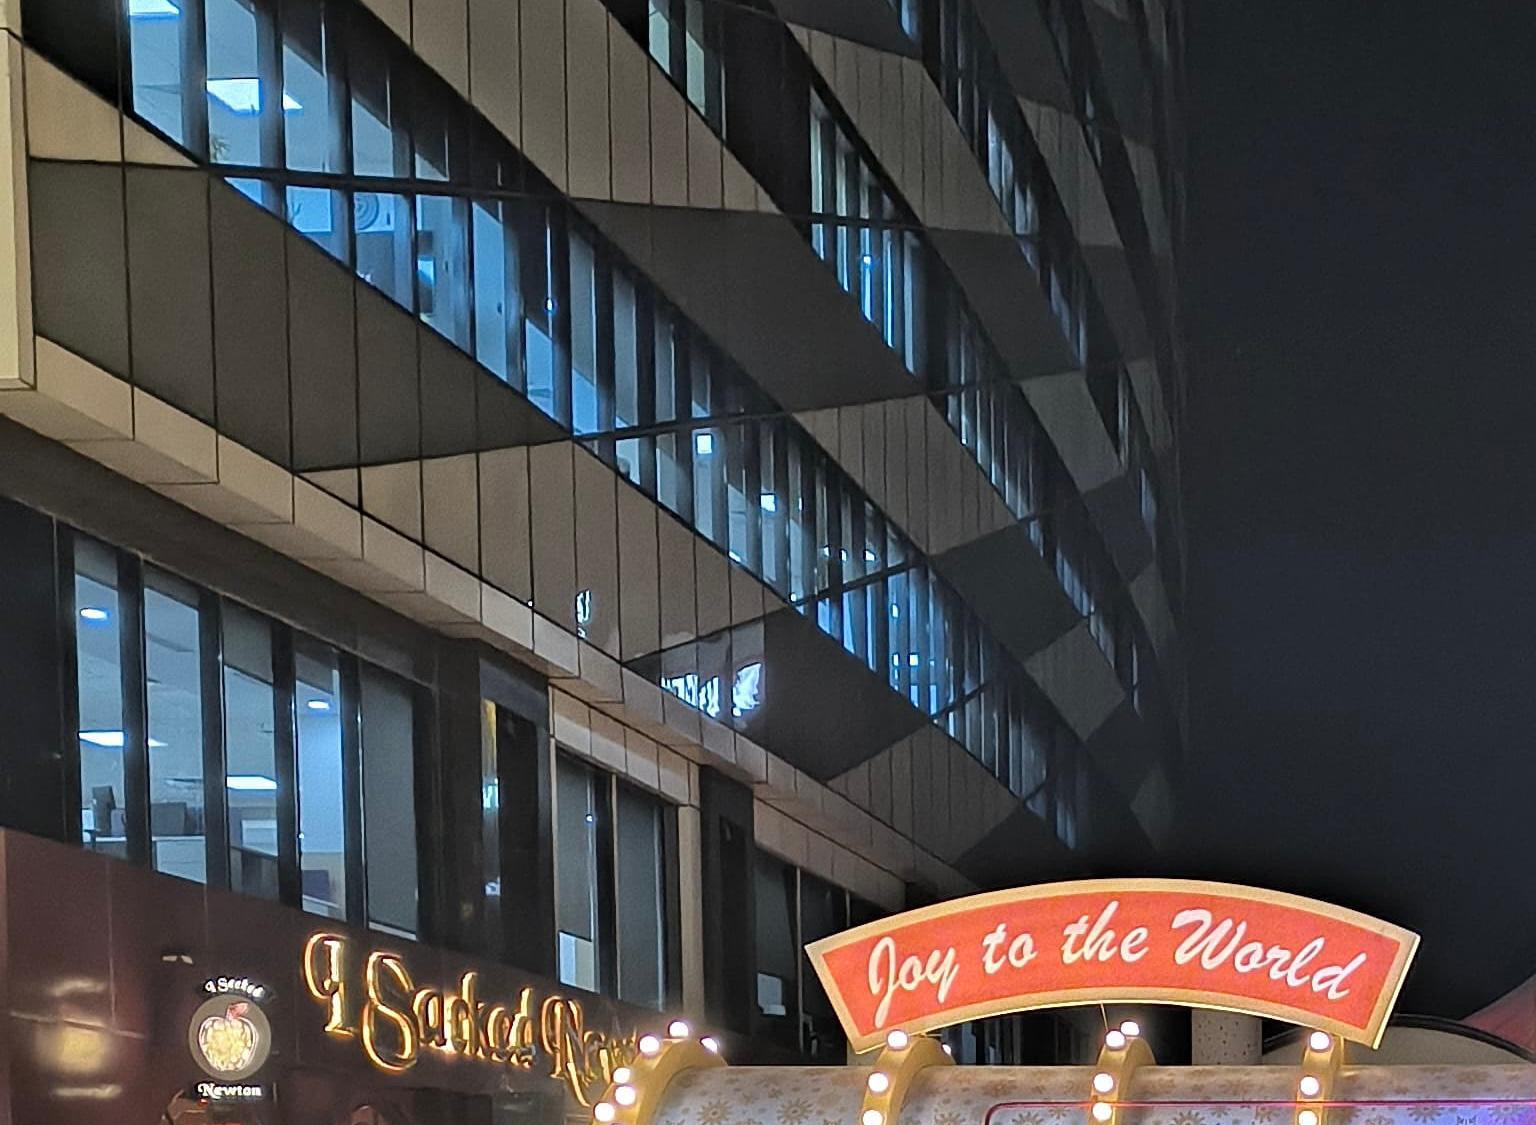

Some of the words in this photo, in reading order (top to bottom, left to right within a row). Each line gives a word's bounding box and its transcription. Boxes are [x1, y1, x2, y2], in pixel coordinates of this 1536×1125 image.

[868, 936, 959, 1029] Joy
[981, 922, 1037, 975] to
[1061, 900, 1149, 963] the
[1171, 908, 1367, 1001] World
[197, 1082, 262, 1100] Newton
